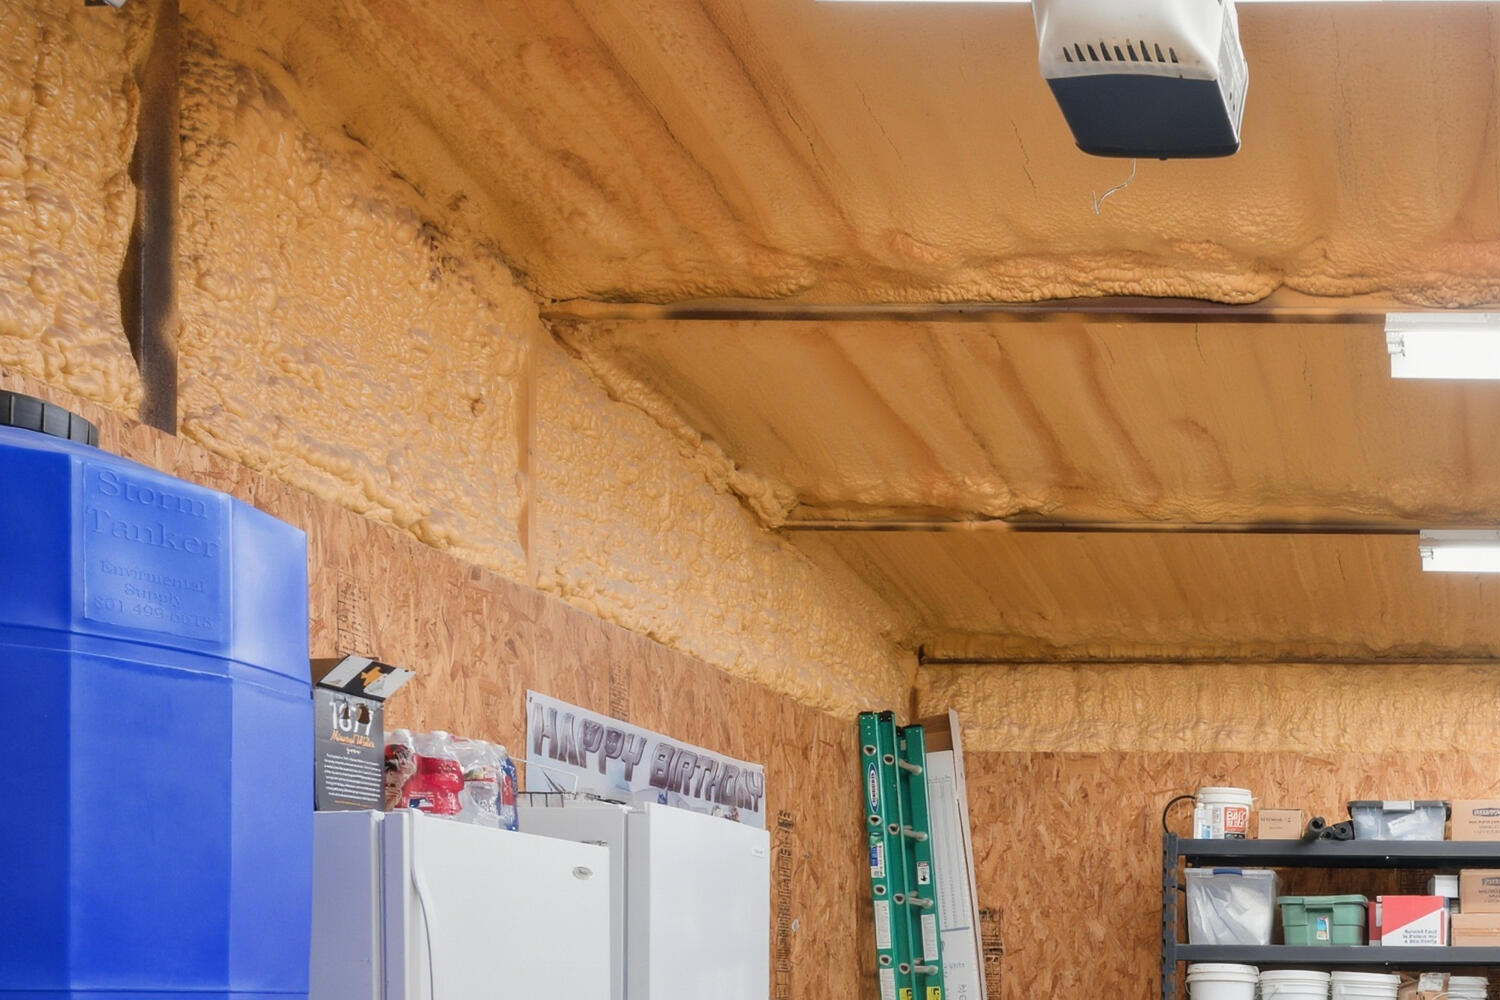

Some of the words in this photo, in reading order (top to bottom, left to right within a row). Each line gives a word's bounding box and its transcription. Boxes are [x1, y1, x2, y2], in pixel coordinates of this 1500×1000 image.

[98, 467, 208, 519] Storm
[86, 505, 219, 558] Tanker
[532, 702, 648, 782] HAPPY
[649, 742, 764, 813] BIRTHDAY
